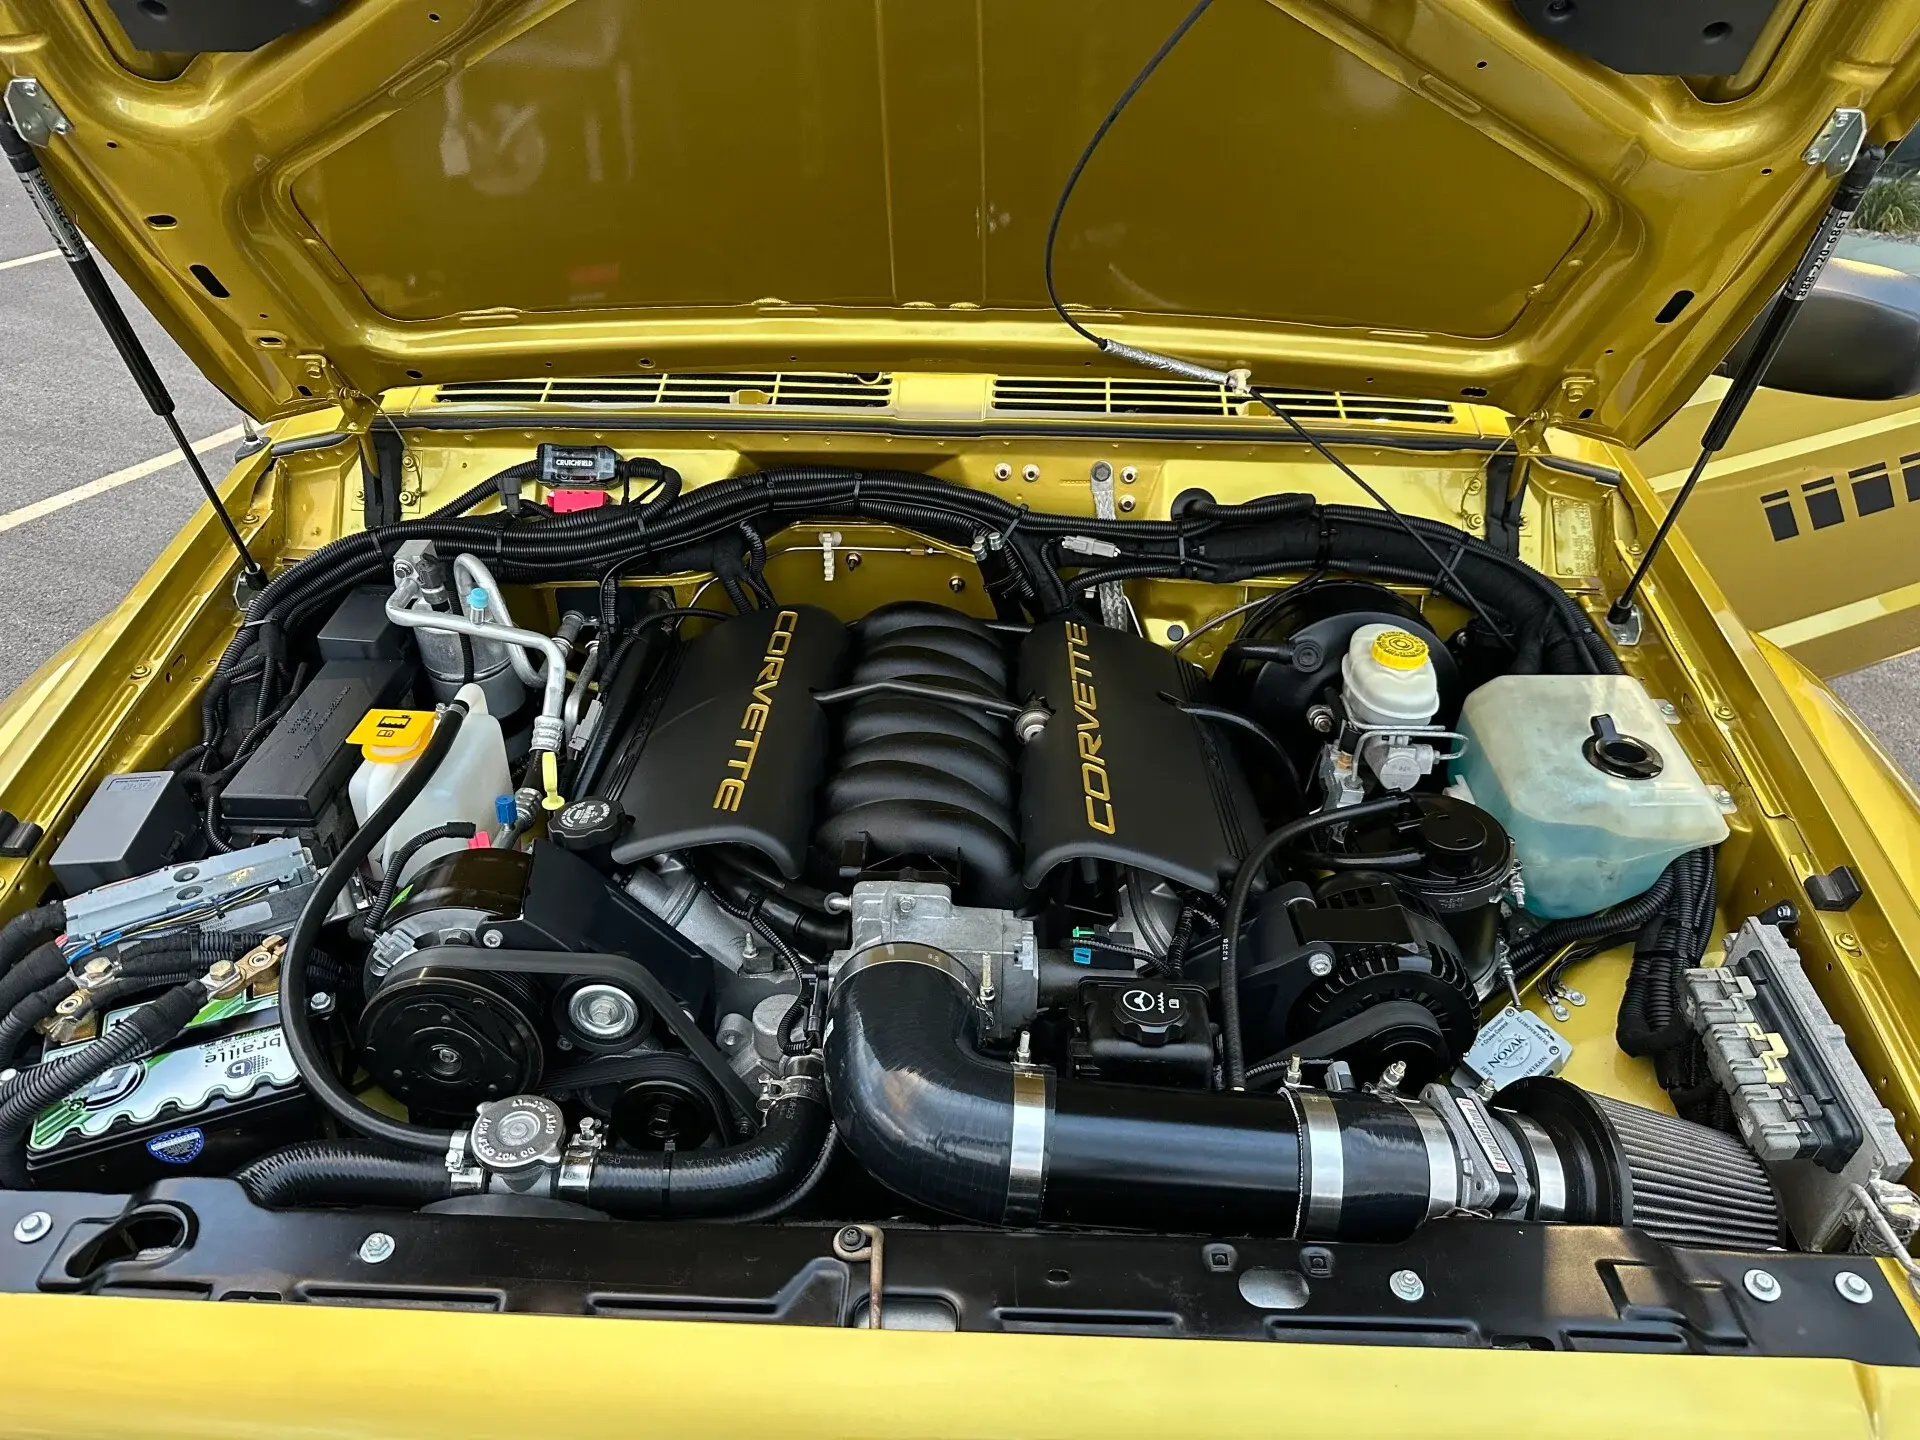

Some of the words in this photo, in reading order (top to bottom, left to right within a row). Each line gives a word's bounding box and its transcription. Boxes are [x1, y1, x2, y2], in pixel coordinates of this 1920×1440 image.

[1797, 215, 1849, 297] 888-220-6861
[555, 459, 594, 467] CRUTCHFIELD
[712, 610, 799, 813] CORVETTE
[1065, 620, 1116, 835] CORVETTE
[1516, 1016, 1549, 1046] SUPERIORITY
[204, 1036, 281, 1064] braille
[1487, 1035, 1527, 1069] NOVAK
